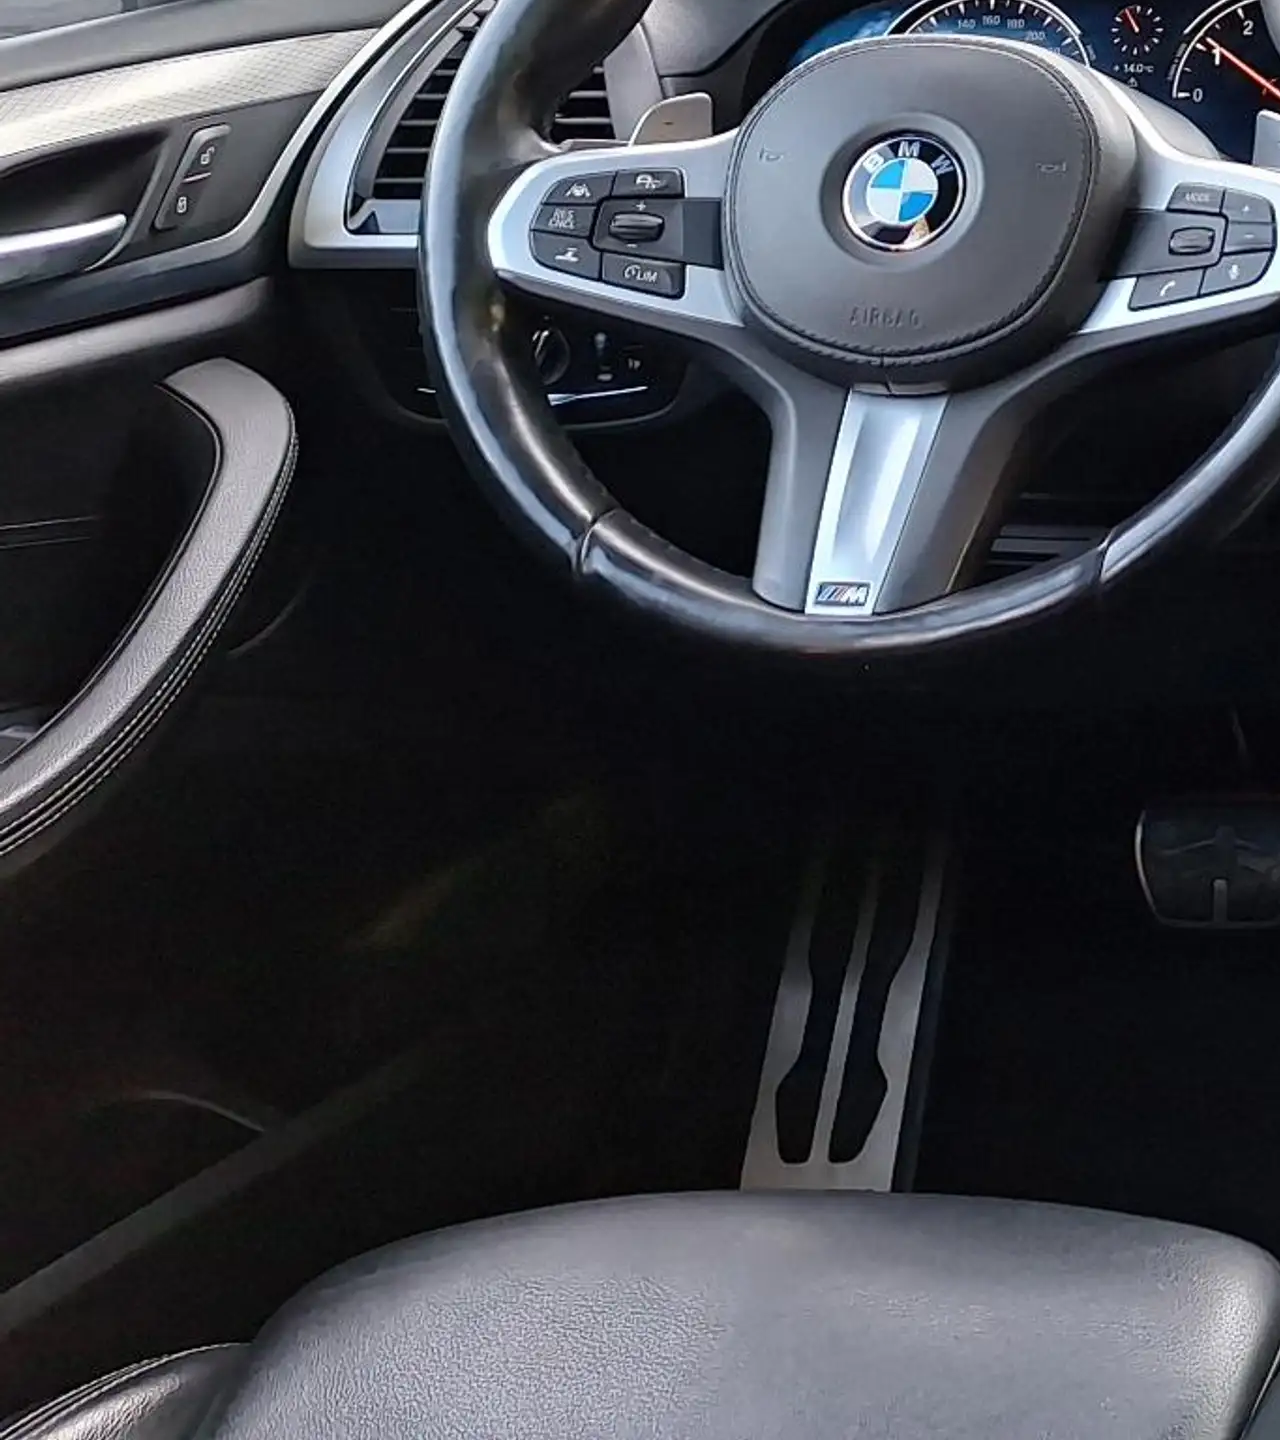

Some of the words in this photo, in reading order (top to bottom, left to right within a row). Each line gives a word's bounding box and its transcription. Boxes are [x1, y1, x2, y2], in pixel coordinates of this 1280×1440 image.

[1242, 20, 1254, 36] 2
[1212, 48, 1221, 66] 1
[1192, 88, 1203, 103] 0
[862, 140, 954, 175] BMW
